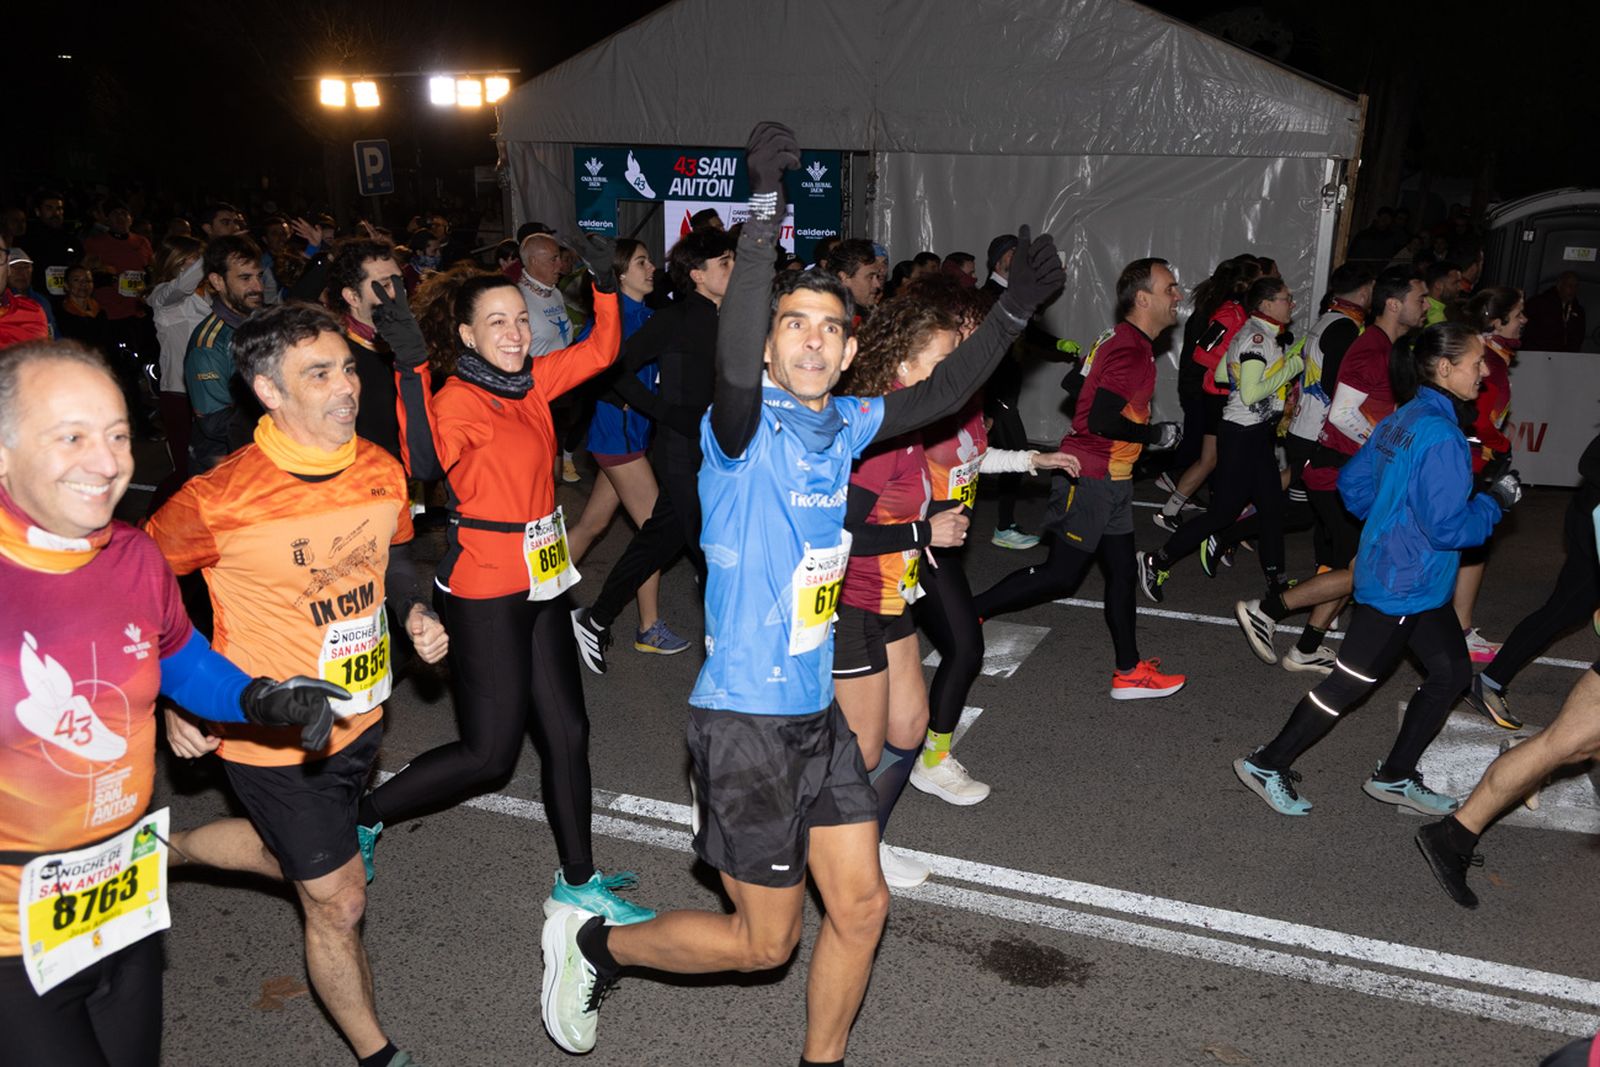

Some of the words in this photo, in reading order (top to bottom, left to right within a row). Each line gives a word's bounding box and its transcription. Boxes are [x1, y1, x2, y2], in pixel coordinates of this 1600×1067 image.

[363, 147, 385, 188] P
[673, 155, 697, 177] 43
[697, 157, 737, 176] SAN
[634, 176, 646, 191] 43
[668, 173, 734, 197] ANTÓN
[578, 220, 613, 228] calderón
[797, 228, 836, 236] calderón
[331, 645, 352, 659] SAN
[341, 640, 385, 685] 1855
[54, 709, 93, 746] 43
[60, 855, 106, 877] NOCHE
[108, 846, 122, 862] DE
[39, 879, 72, 898] SAN
[53, 864, 139, 931] 8763
